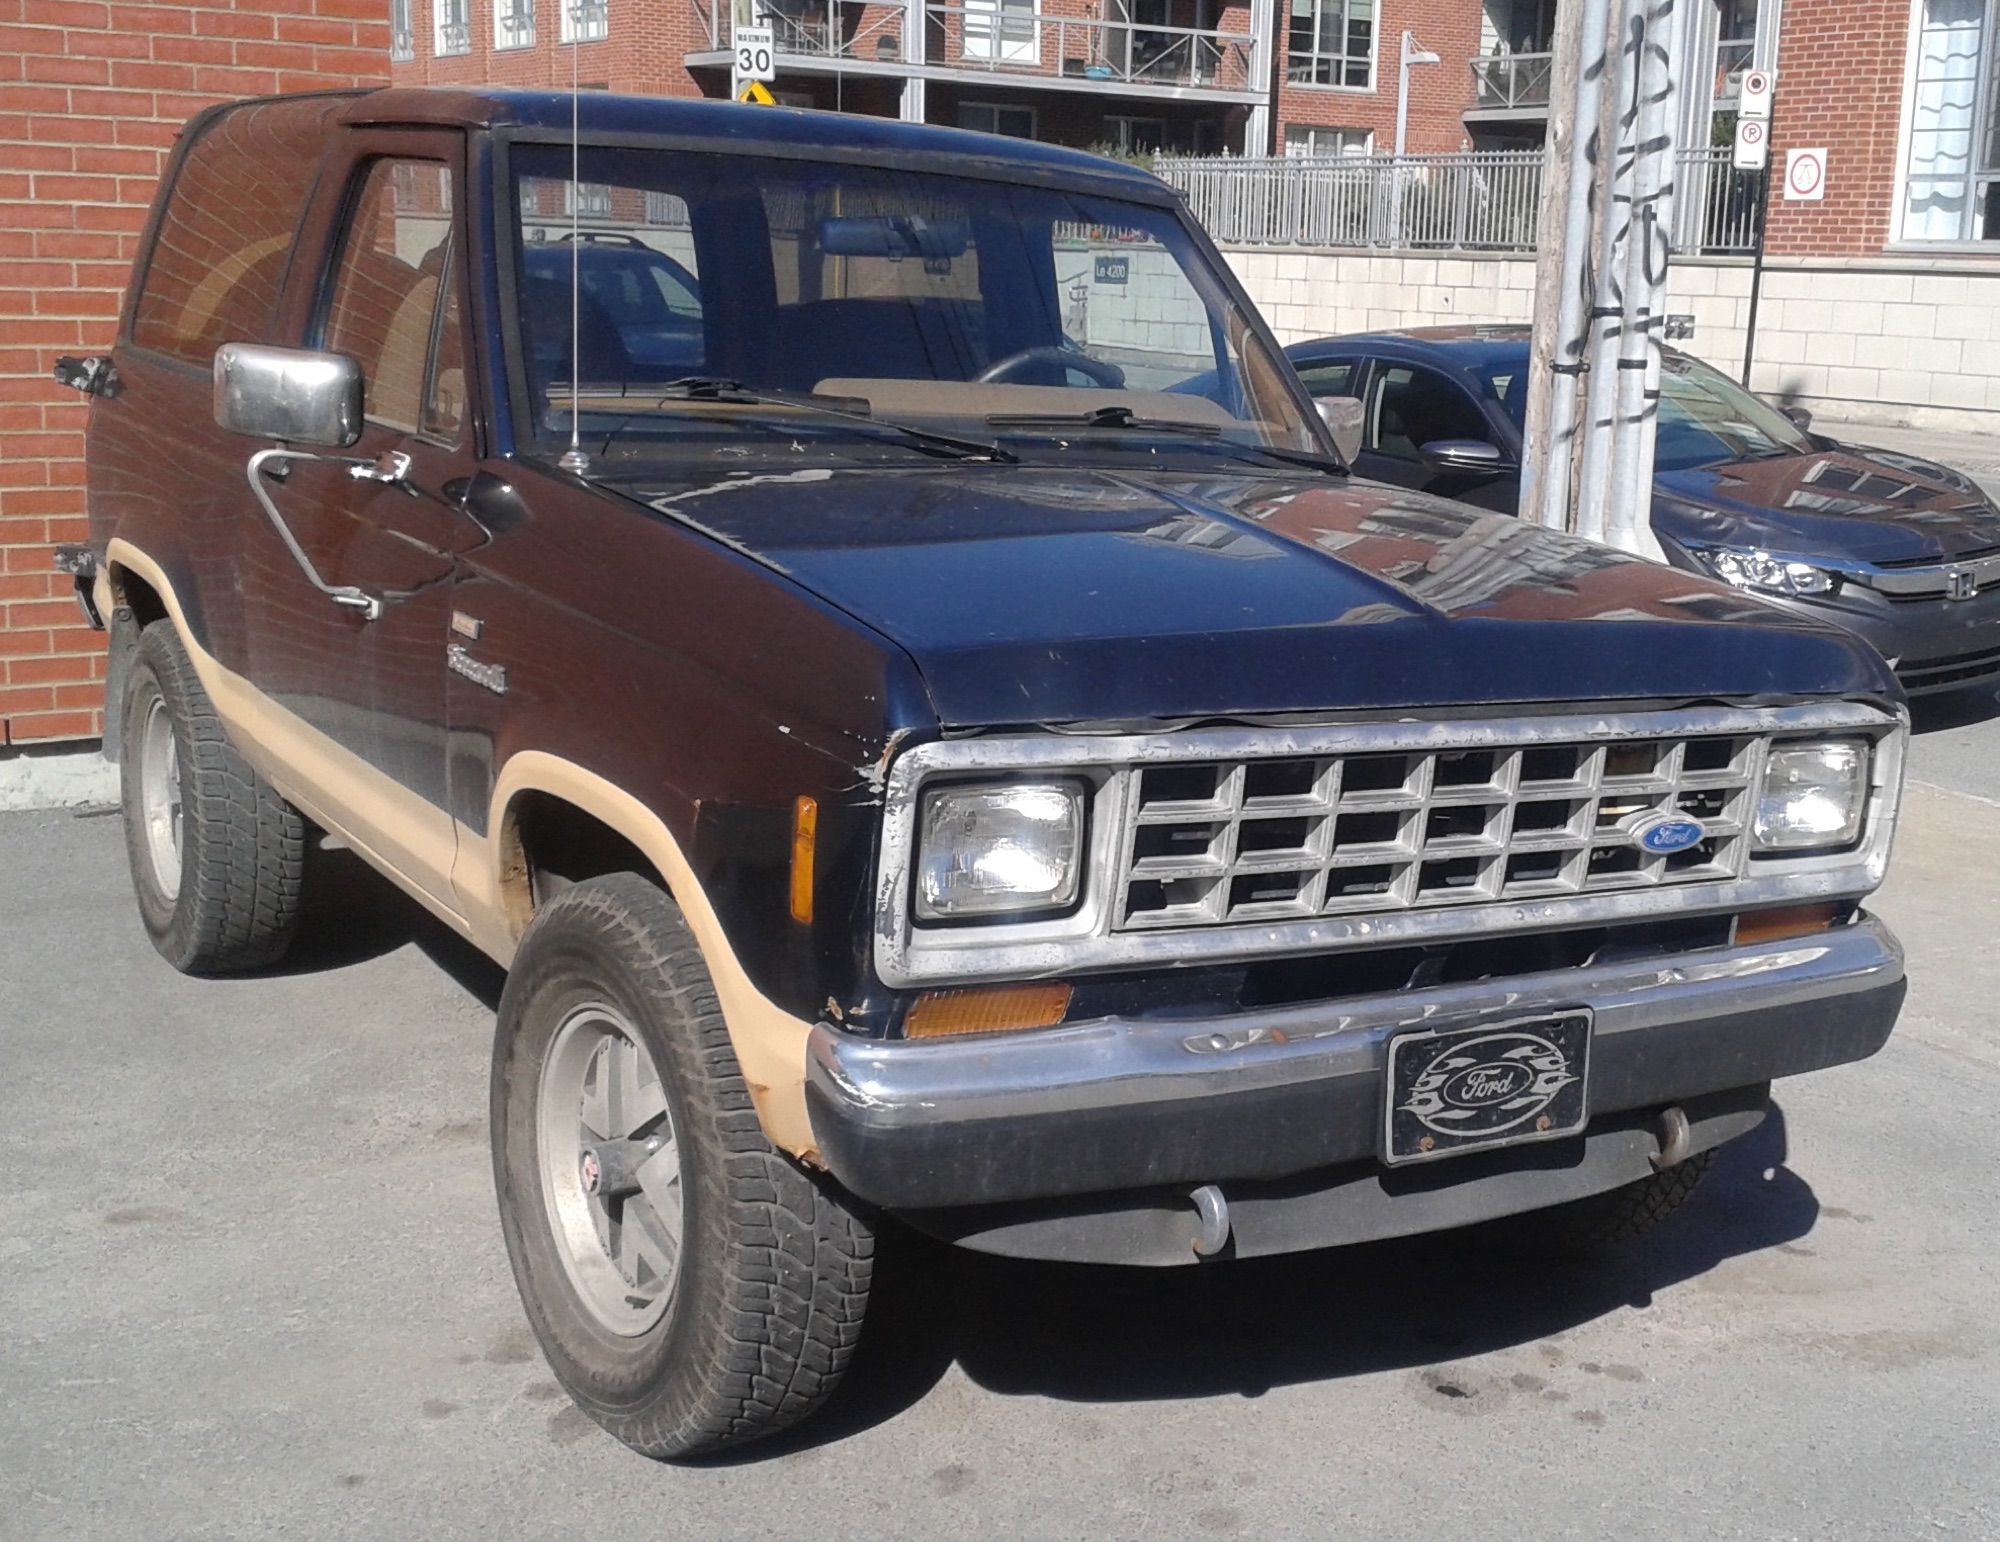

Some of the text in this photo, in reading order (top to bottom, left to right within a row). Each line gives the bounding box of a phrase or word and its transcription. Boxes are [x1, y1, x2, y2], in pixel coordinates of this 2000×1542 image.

[739, 47, 770, 72] 30
[1653, 825, 1692, 845] Ford
[1461, 1068, 1515, 1100] Ford
